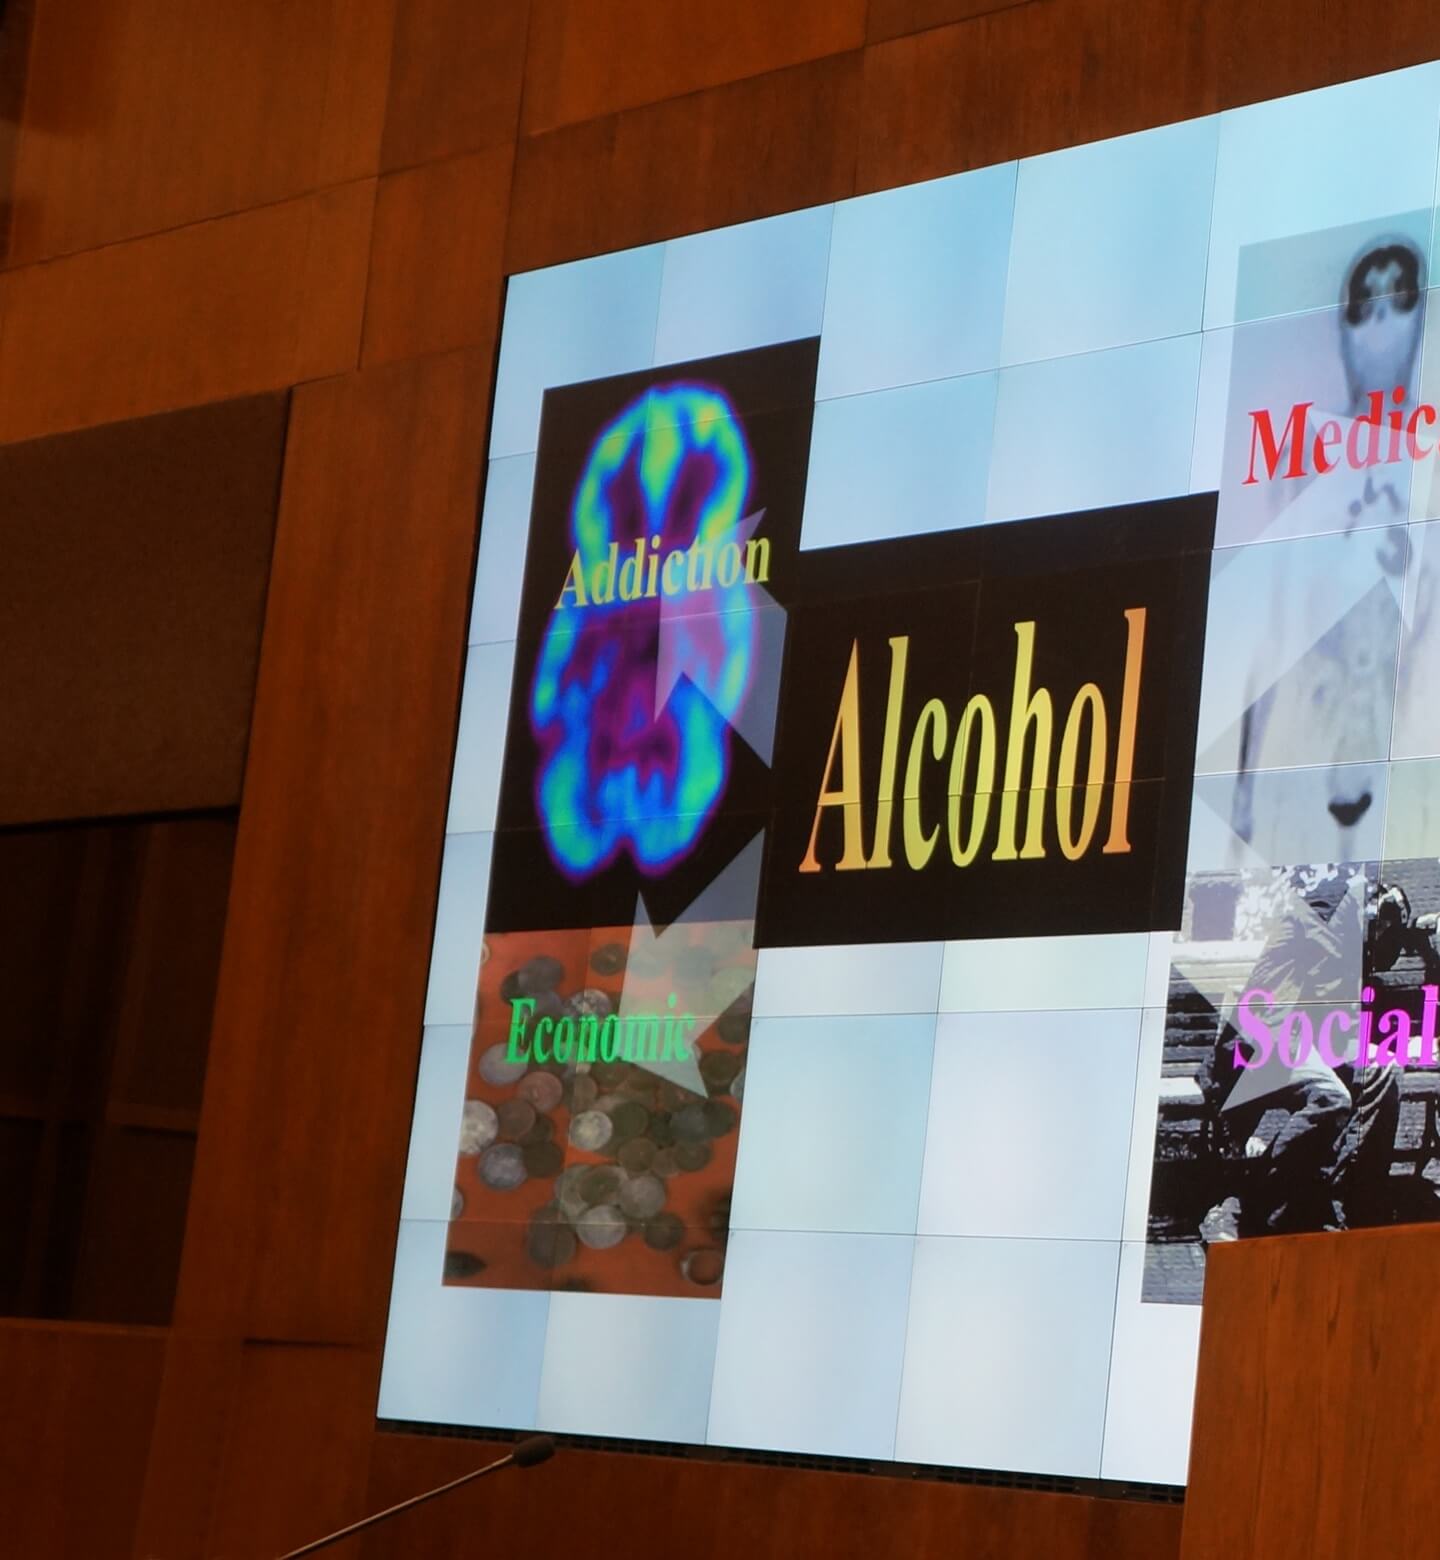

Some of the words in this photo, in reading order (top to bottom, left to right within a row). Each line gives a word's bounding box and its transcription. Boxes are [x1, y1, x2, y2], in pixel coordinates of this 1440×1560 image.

[553, 534, 770, 609] Addiction
[799, 607, 1146, 872] Alcohol
[504, 992, 695, 1064] Economic
[1232, 984, 1440, 1070] Social
